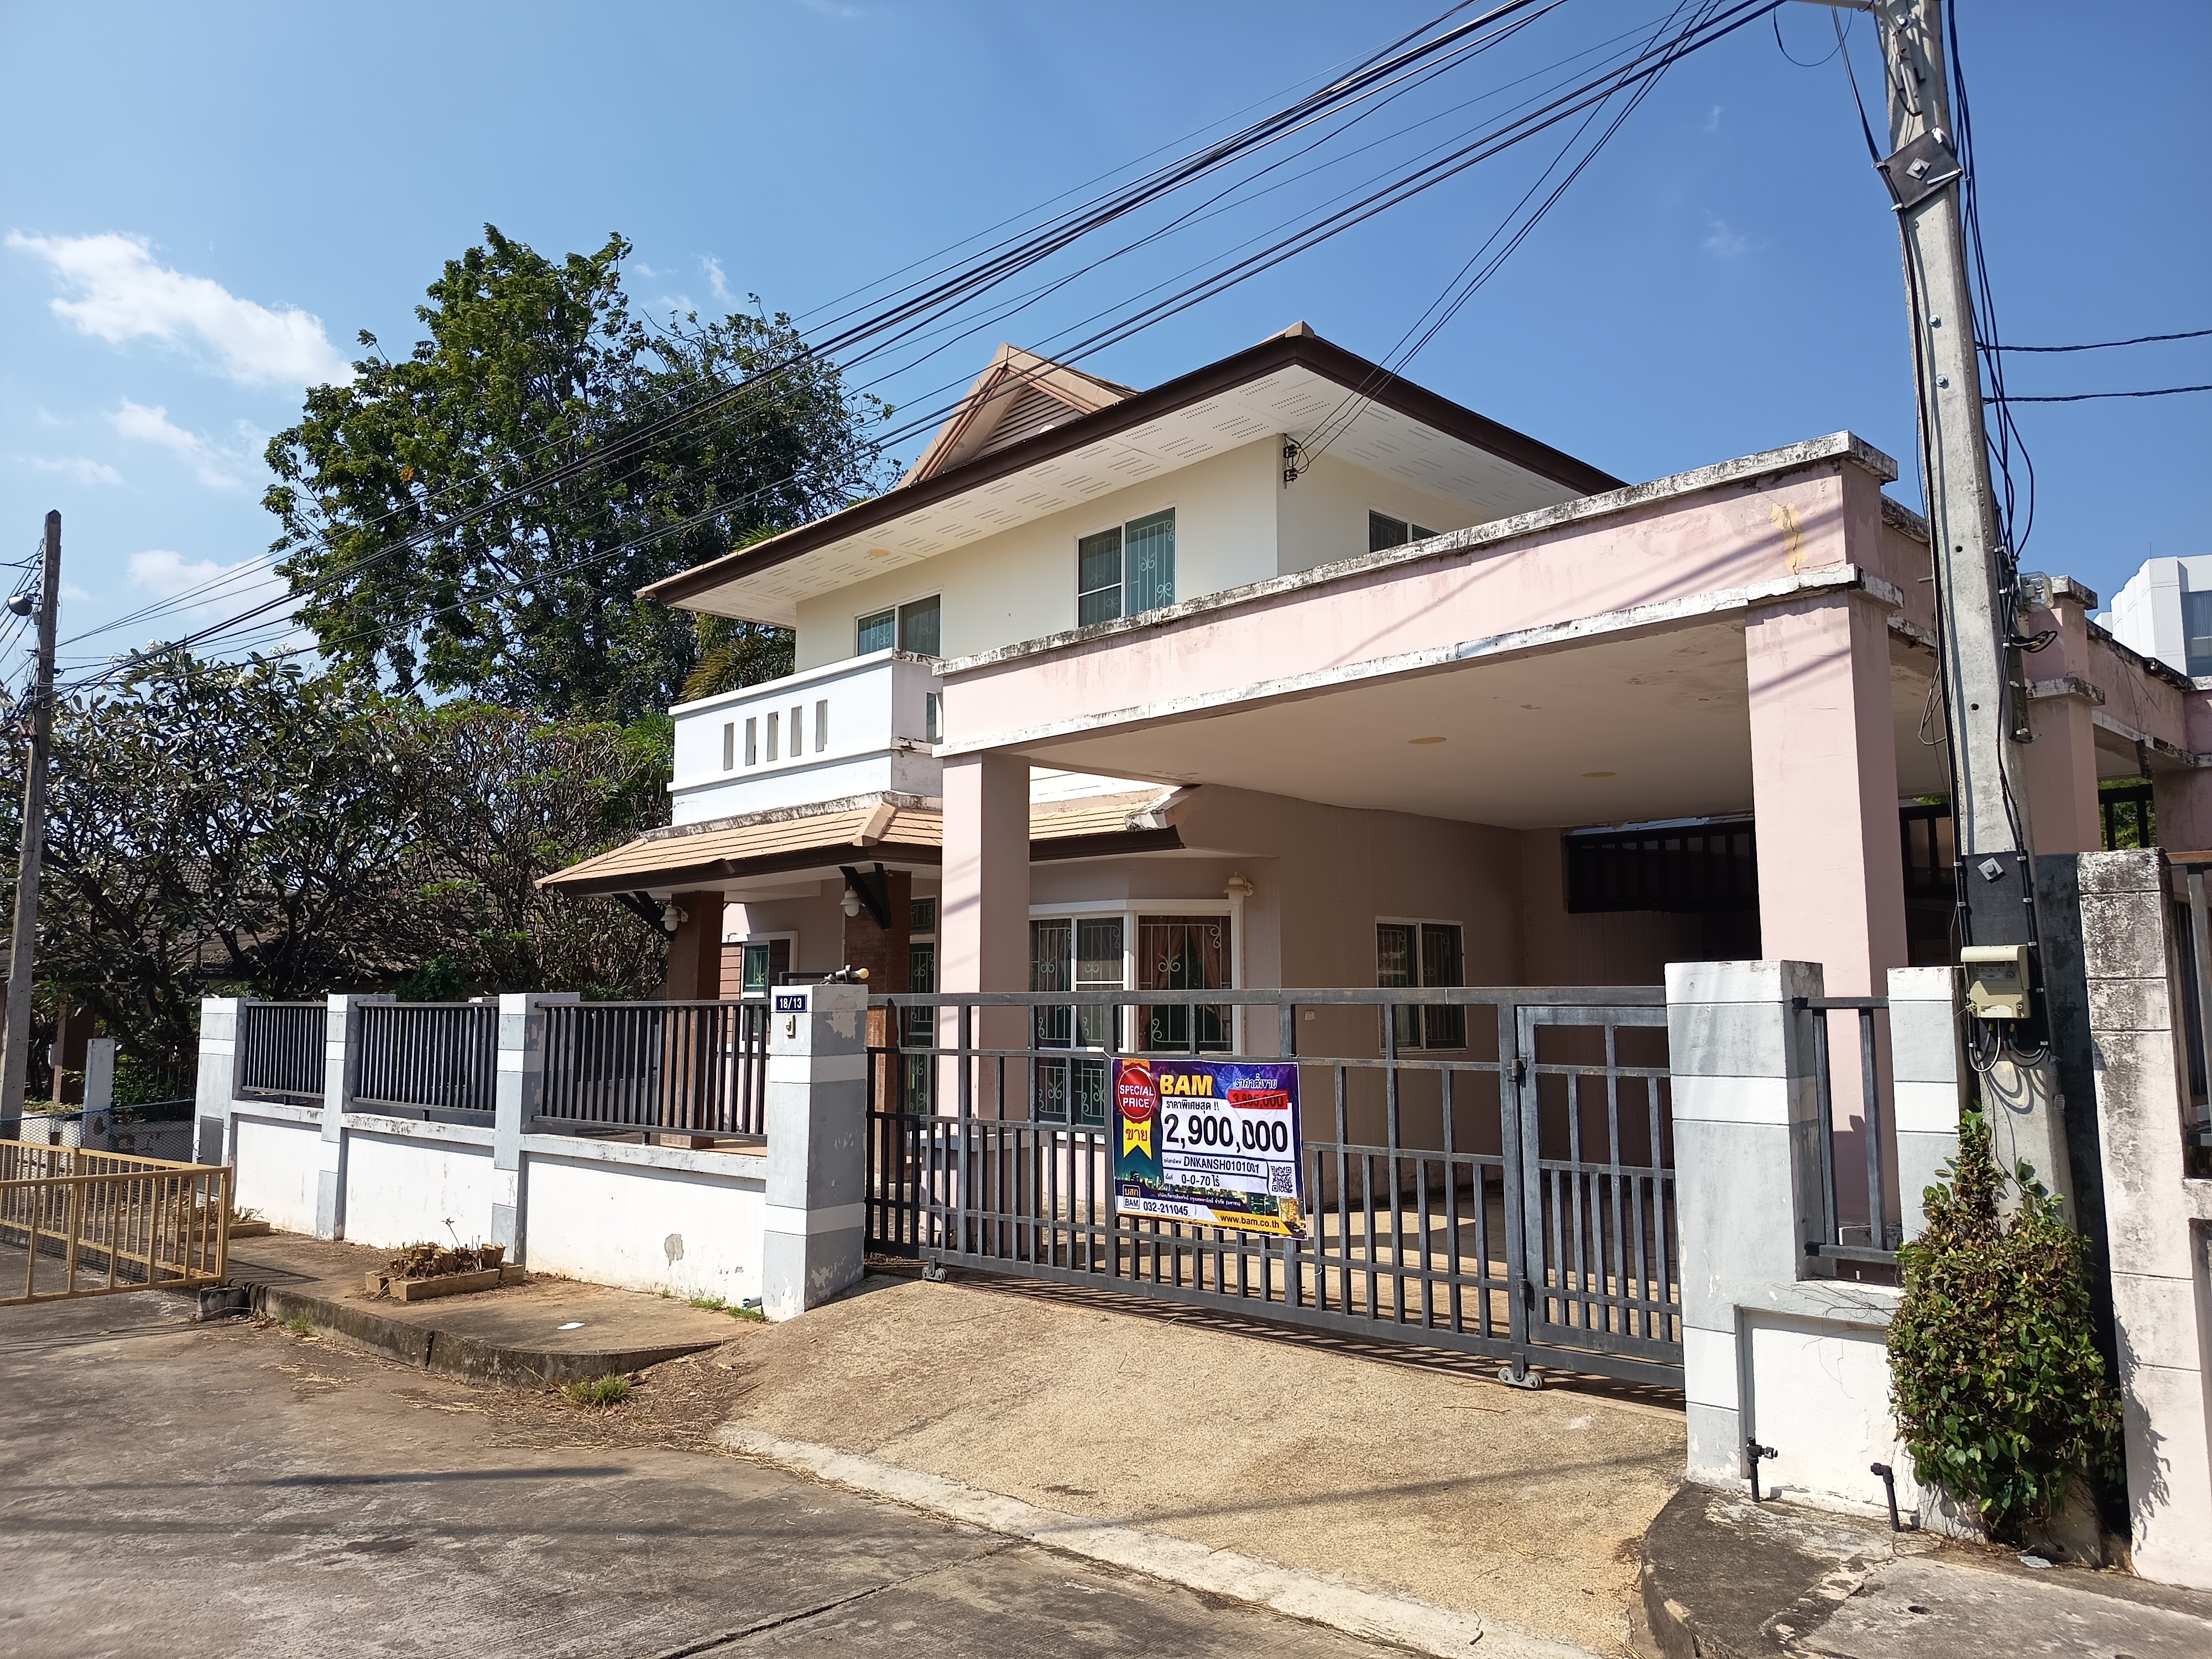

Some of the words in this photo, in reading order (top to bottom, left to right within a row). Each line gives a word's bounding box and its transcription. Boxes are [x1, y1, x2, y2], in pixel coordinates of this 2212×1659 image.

[780, 997, 802, 1009] 18/13
[1160, 1074, 1213, 1096] BAM
[1235, 1073, 1277, 1089] ราคาตั้งขาย
[1119, 1084, 1154, 1096] SPECIAL
[1123, 1097, 1150, 1108] PRICE
[1166, 1099, 1211, 1114] ราคาพิเศษสุด
[1125, 1128, 1148, 1141] ขาย
[1164, 1113, 1288, 1154] 2,900,000
[1183, 1156, 1259, 1174] DNKANSH0101001
[1182, 1174, 1211, 1186] 0-0-70
[1211, 1174, 1220, 1187] ไร่
[1124, 1188, 1139, 1197] บสก
[1125, 1198, 1139, 1207] BAM
[1143, 1201, 1188, 1216] 032-211045
[1220, 1215, 1280, 1229] www.bam.co.th
